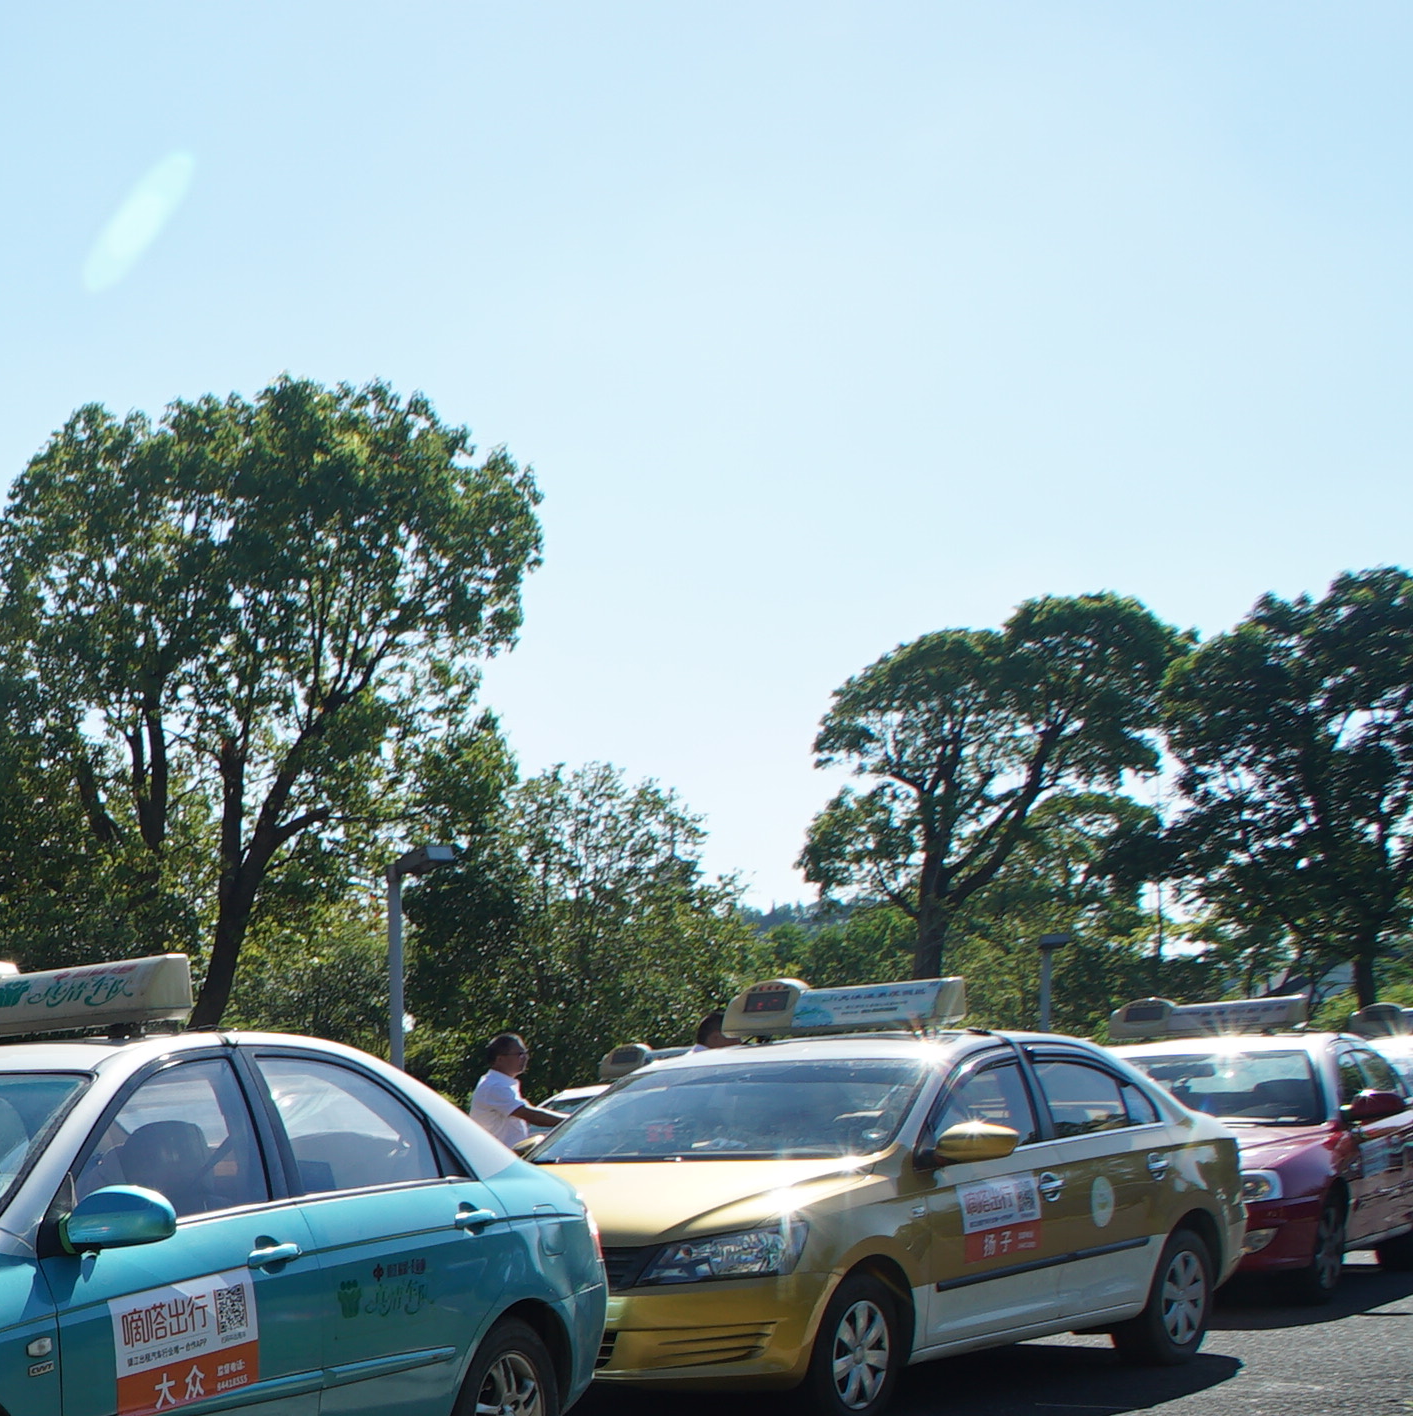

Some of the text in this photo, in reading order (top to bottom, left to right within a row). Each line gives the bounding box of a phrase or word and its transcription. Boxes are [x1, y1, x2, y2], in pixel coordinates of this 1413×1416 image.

[121, 1294, 208, 1348] 嘀嗒出行
[154, 1364, 205, 1410] 大众
